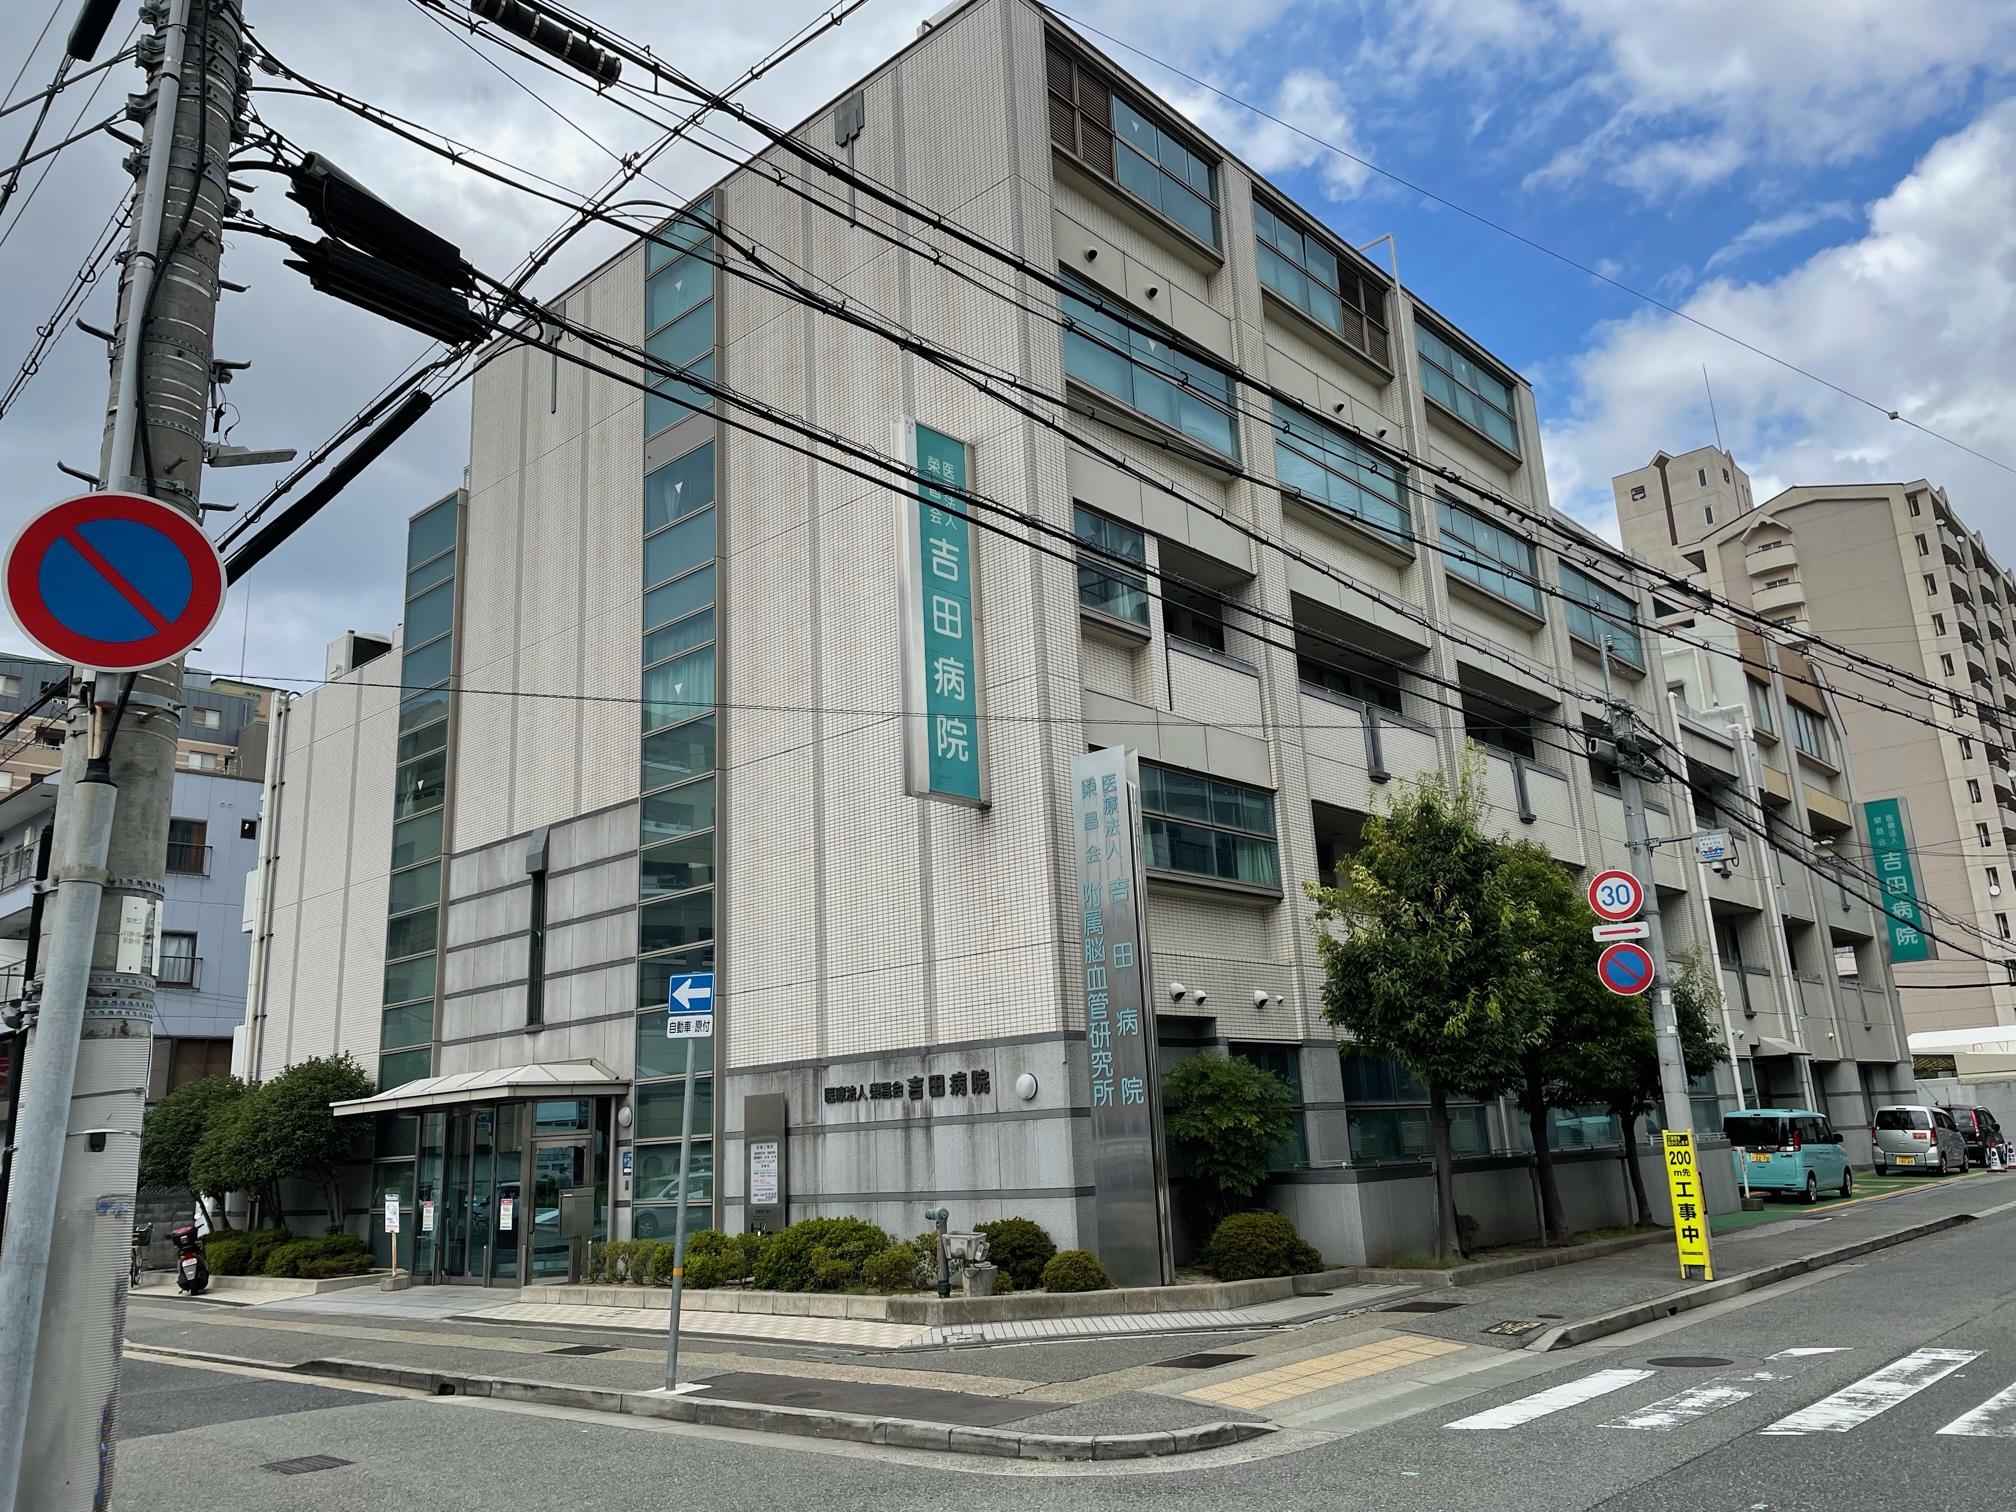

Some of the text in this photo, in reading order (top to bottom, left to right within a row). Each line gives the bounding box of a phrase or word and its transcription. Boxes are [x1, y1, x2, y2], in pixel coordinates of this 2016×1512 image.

[942, 460, 958, 530] 医法人
[928, 537, 969, 763] 吉田病院
[1101, 773, 1121, 861] 医療法人
[1600, 884, 1630, 907] 30
[1881, 852, 1918, 946] 吉田病院
[1082, 882, 1115, 1107] 附属脳血管研究所
[1108, 876, 1145, 1106] 吉田病院
[907, 1069, 991, 1100] 吉田病院
[1669, 1150, 1691, 1165] 200
[1673, 1168, 1691, 1177] m先
[1675, 1181, 1700, 1244] 工事中
